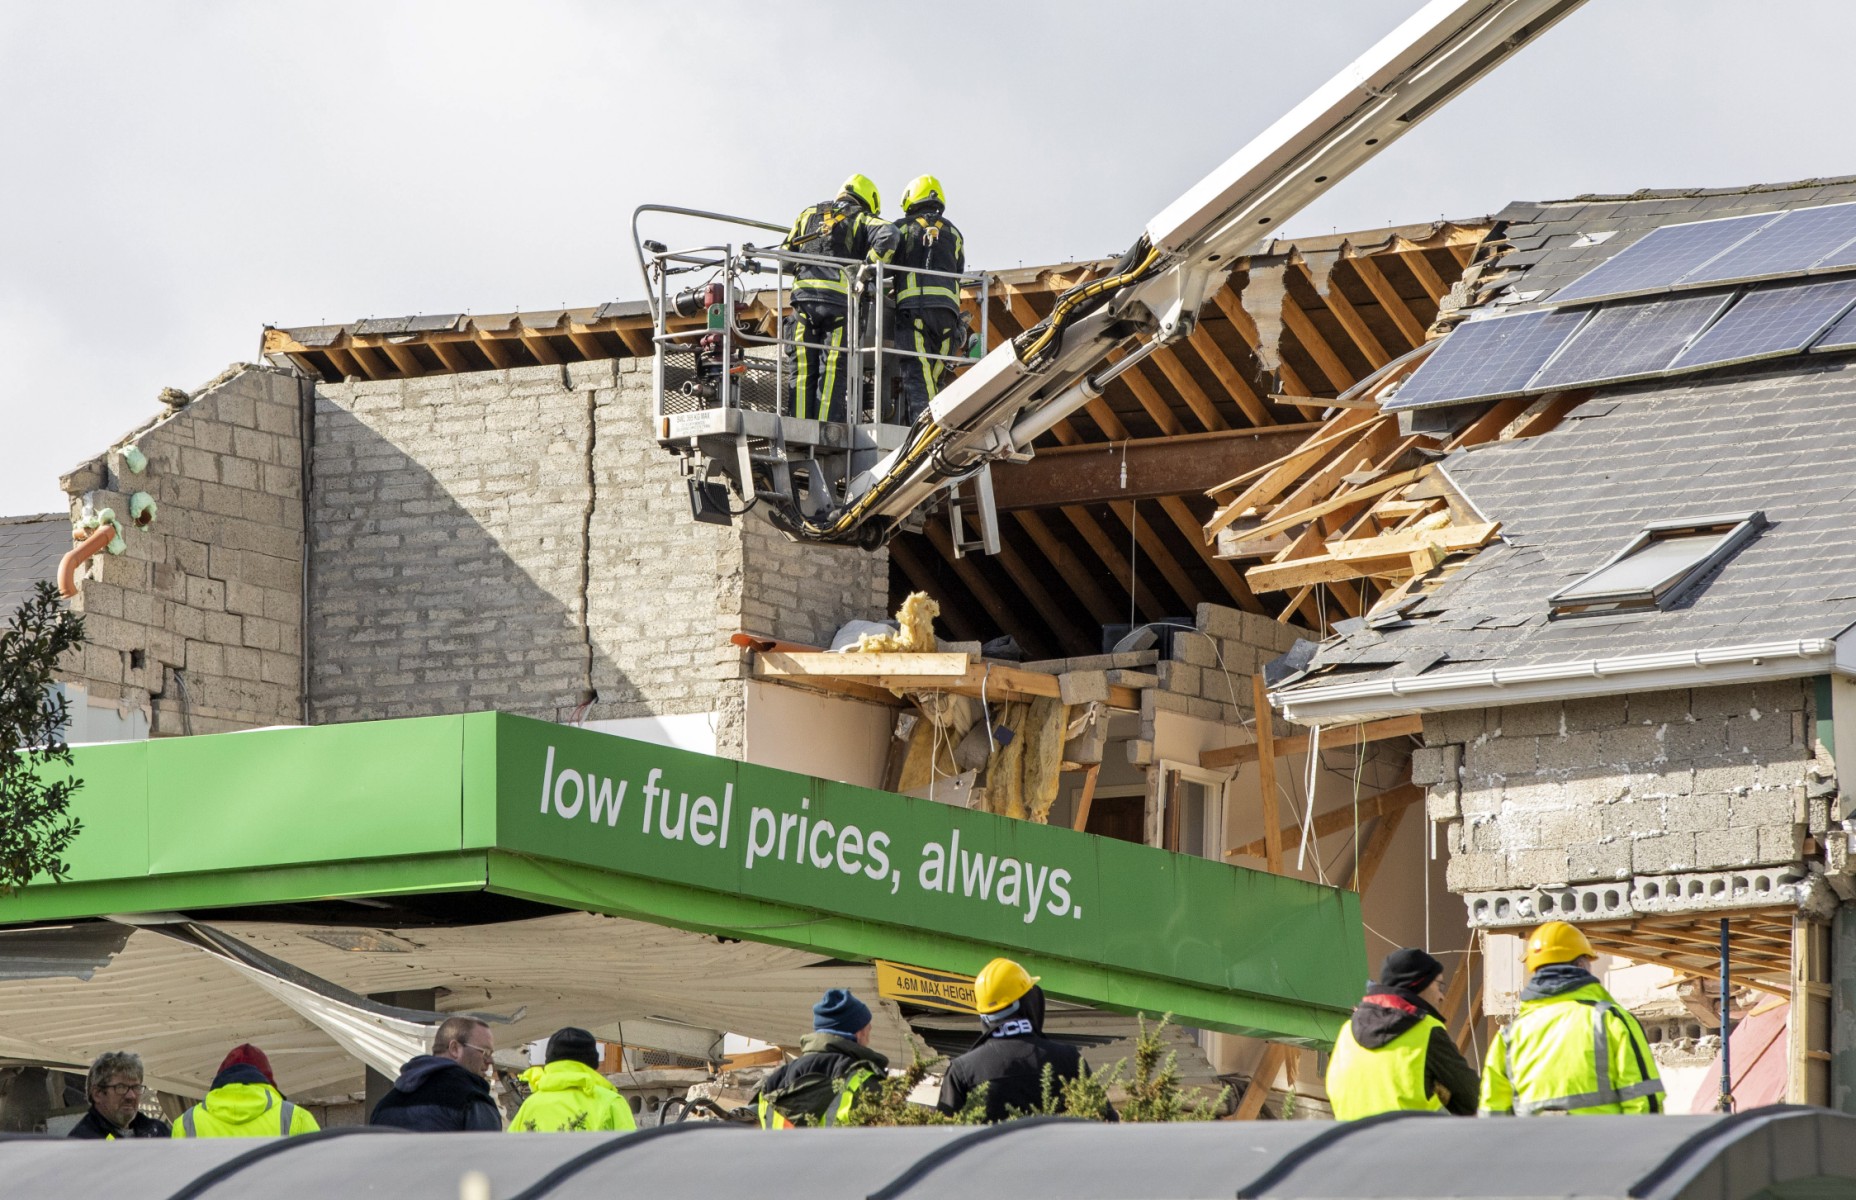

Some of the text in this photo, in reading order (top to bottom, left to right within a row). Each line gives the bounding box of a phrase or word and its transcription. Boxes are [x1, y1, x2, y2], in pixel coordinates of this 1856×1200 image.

[540, 746, 1082, 924] low fuel prices, always.
[896, 976, 977, 1003] 4.6M MAX HEIGHT
[992, 1018, 1033, 1038] JCB
